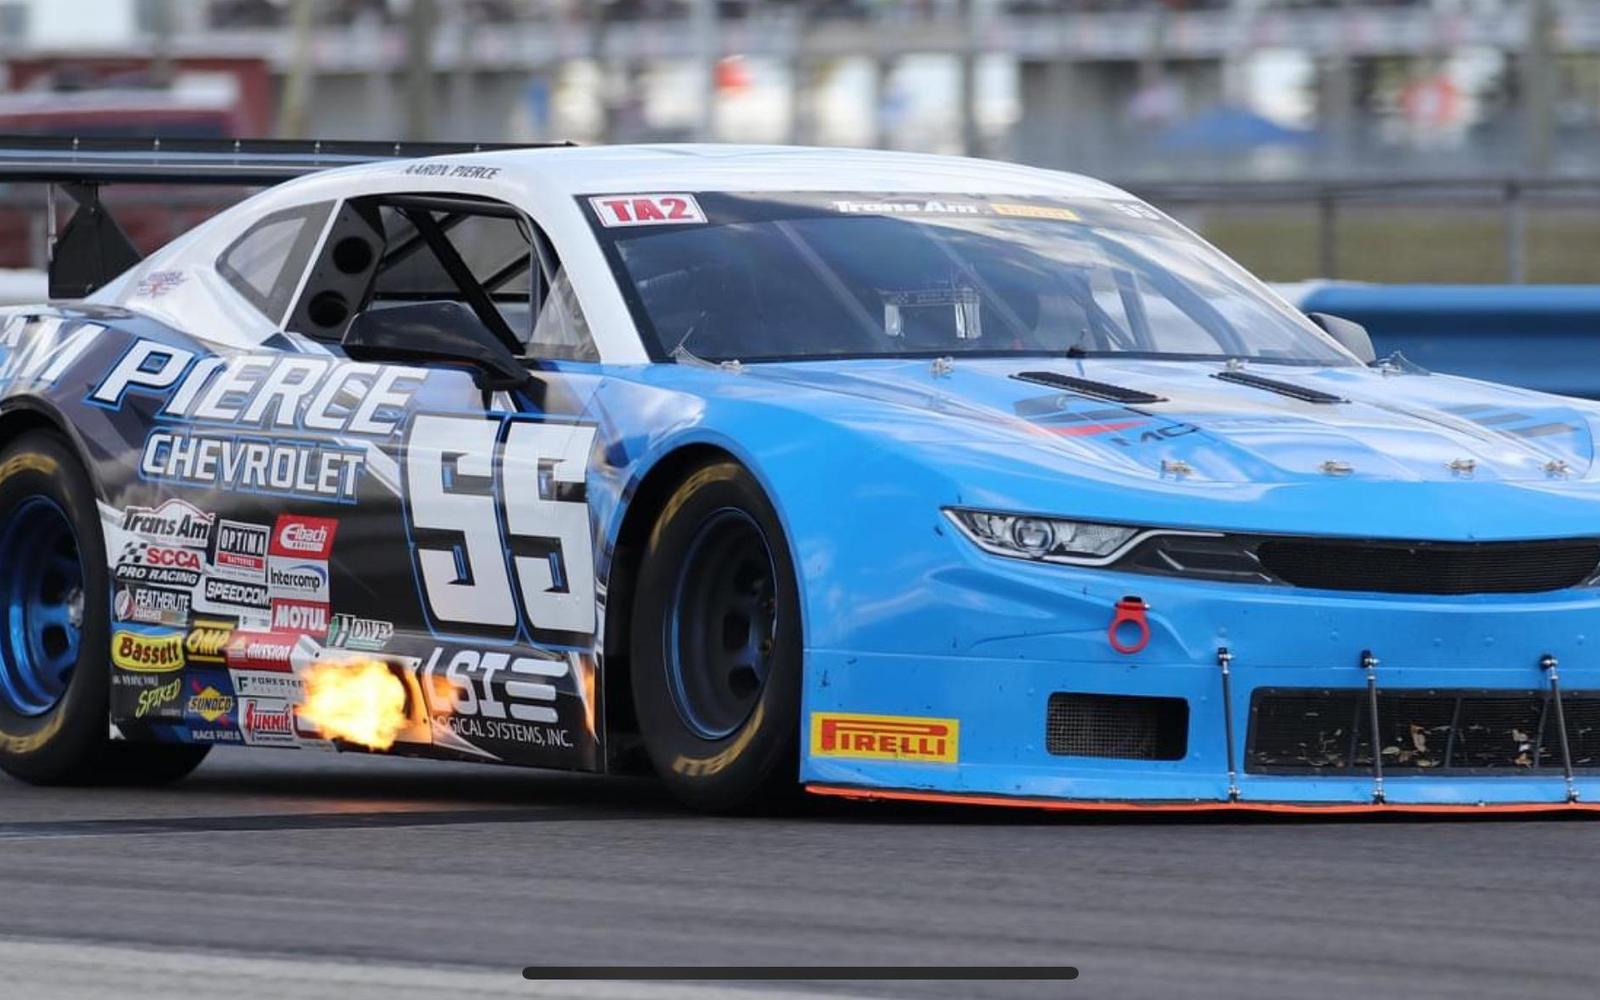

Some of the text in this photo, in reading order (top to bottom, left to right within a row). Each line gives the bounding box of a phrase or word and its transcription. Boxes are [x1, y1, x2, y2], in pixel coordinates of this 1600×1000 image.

[449, 165, 501, 180] PIERCE
[602, 197, 694, 223] TA2
[833, 199, 978, 214] Trans Am
[92, 338, 429, 434] PIERCE
[143, 434, 364, 495] CHEVROLET
[122, 507, 209, 539] Trans Am
[281, 523, 328, 546] Eibach
[405, 415, 597, 634] 55
[220, 528, 265, 556] OPTIMA
[146, 547, 200, 570] SCCA
[116, 565, 198, 585] PRO RACING
[270, 568, 321, 592] Intercomp
[135, 588, 191, 612] FEATHERLITE
[274, 604, 328, 631] MOTUL
[119, 636, 179, 665] Bassett
[186, 628, 231, 655] OMP
[487, 720, 546, 747] SYSTEMS,
[546, 727, 574, 748] INC.
[821, 719, 948, 756] PIRELLI
